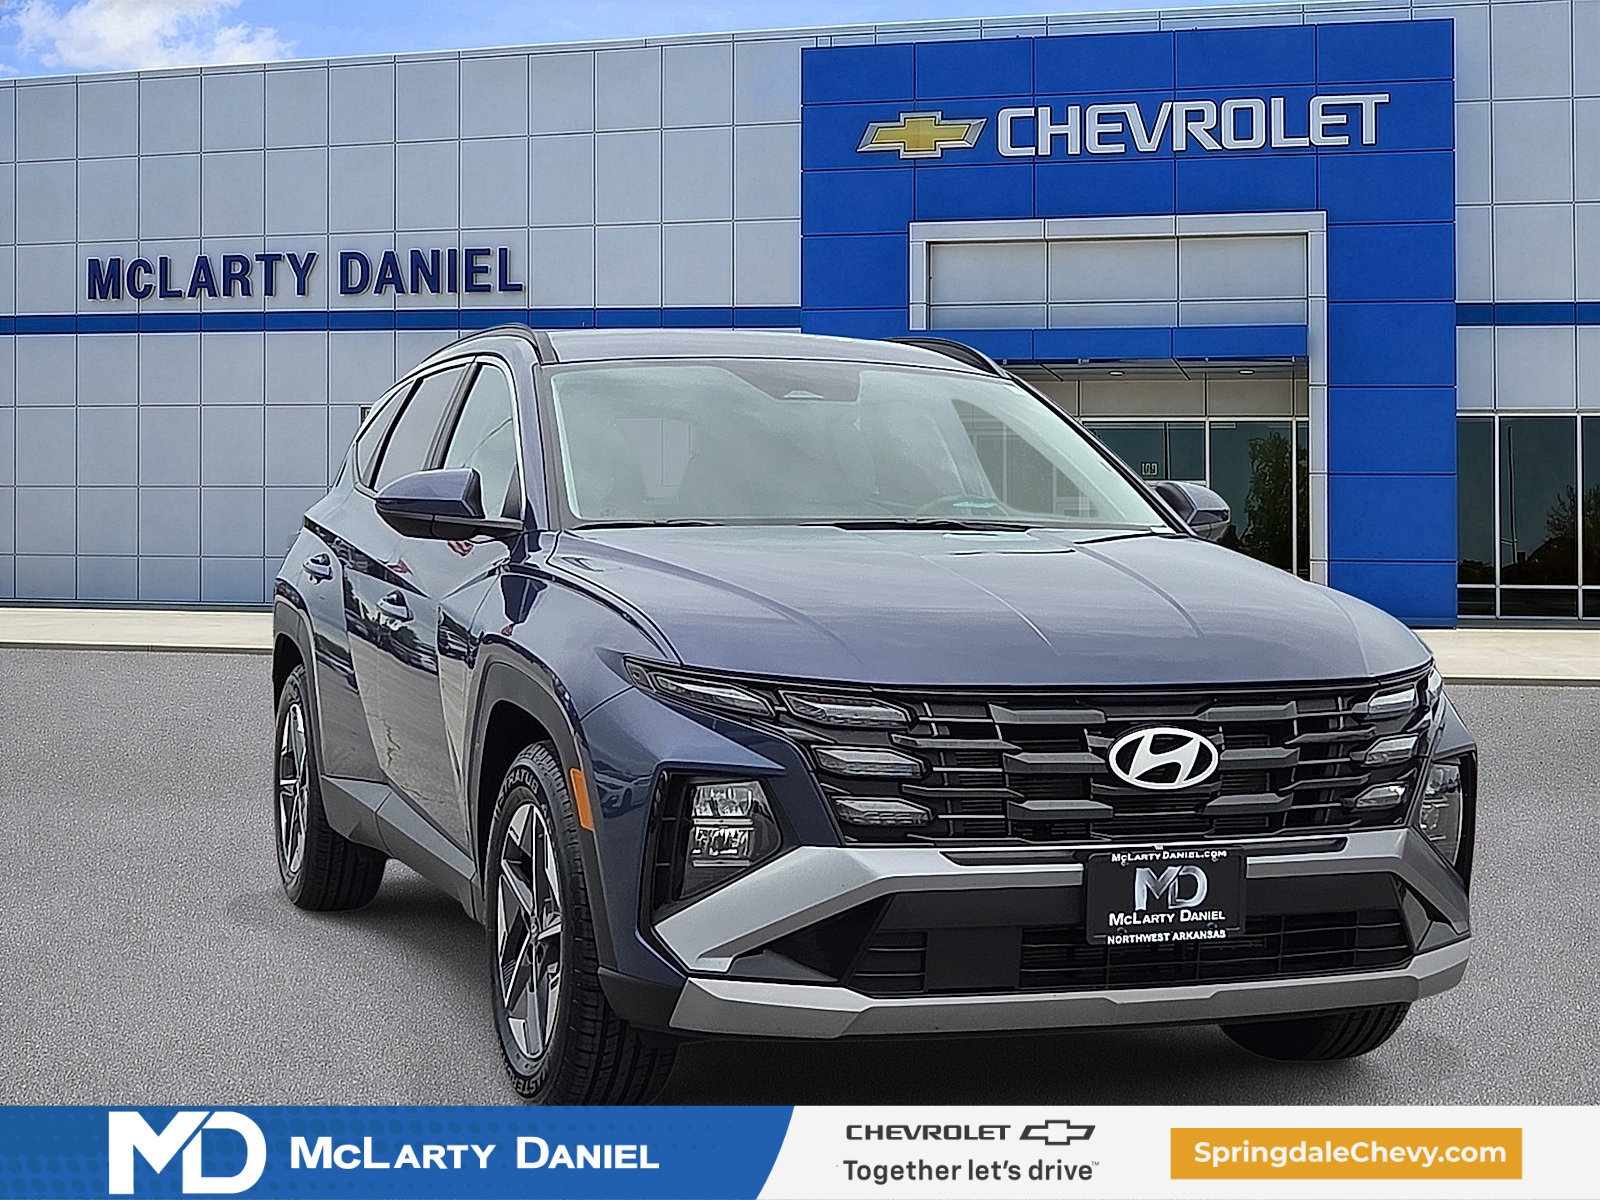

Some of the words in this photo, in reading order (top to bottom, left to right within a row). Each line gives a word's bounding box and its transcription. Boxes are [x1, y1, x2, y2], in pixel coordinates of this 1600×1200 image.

[997, 93, 1390, 157] CHEVROLET
[338, 246, 526, 296] DANIEL
[1179, 909, 1226, 922] DANIEL
[1107, 932, 1171, 945] NORTHWEST
[1172, 929, 1227, 941] ARKANSAS
